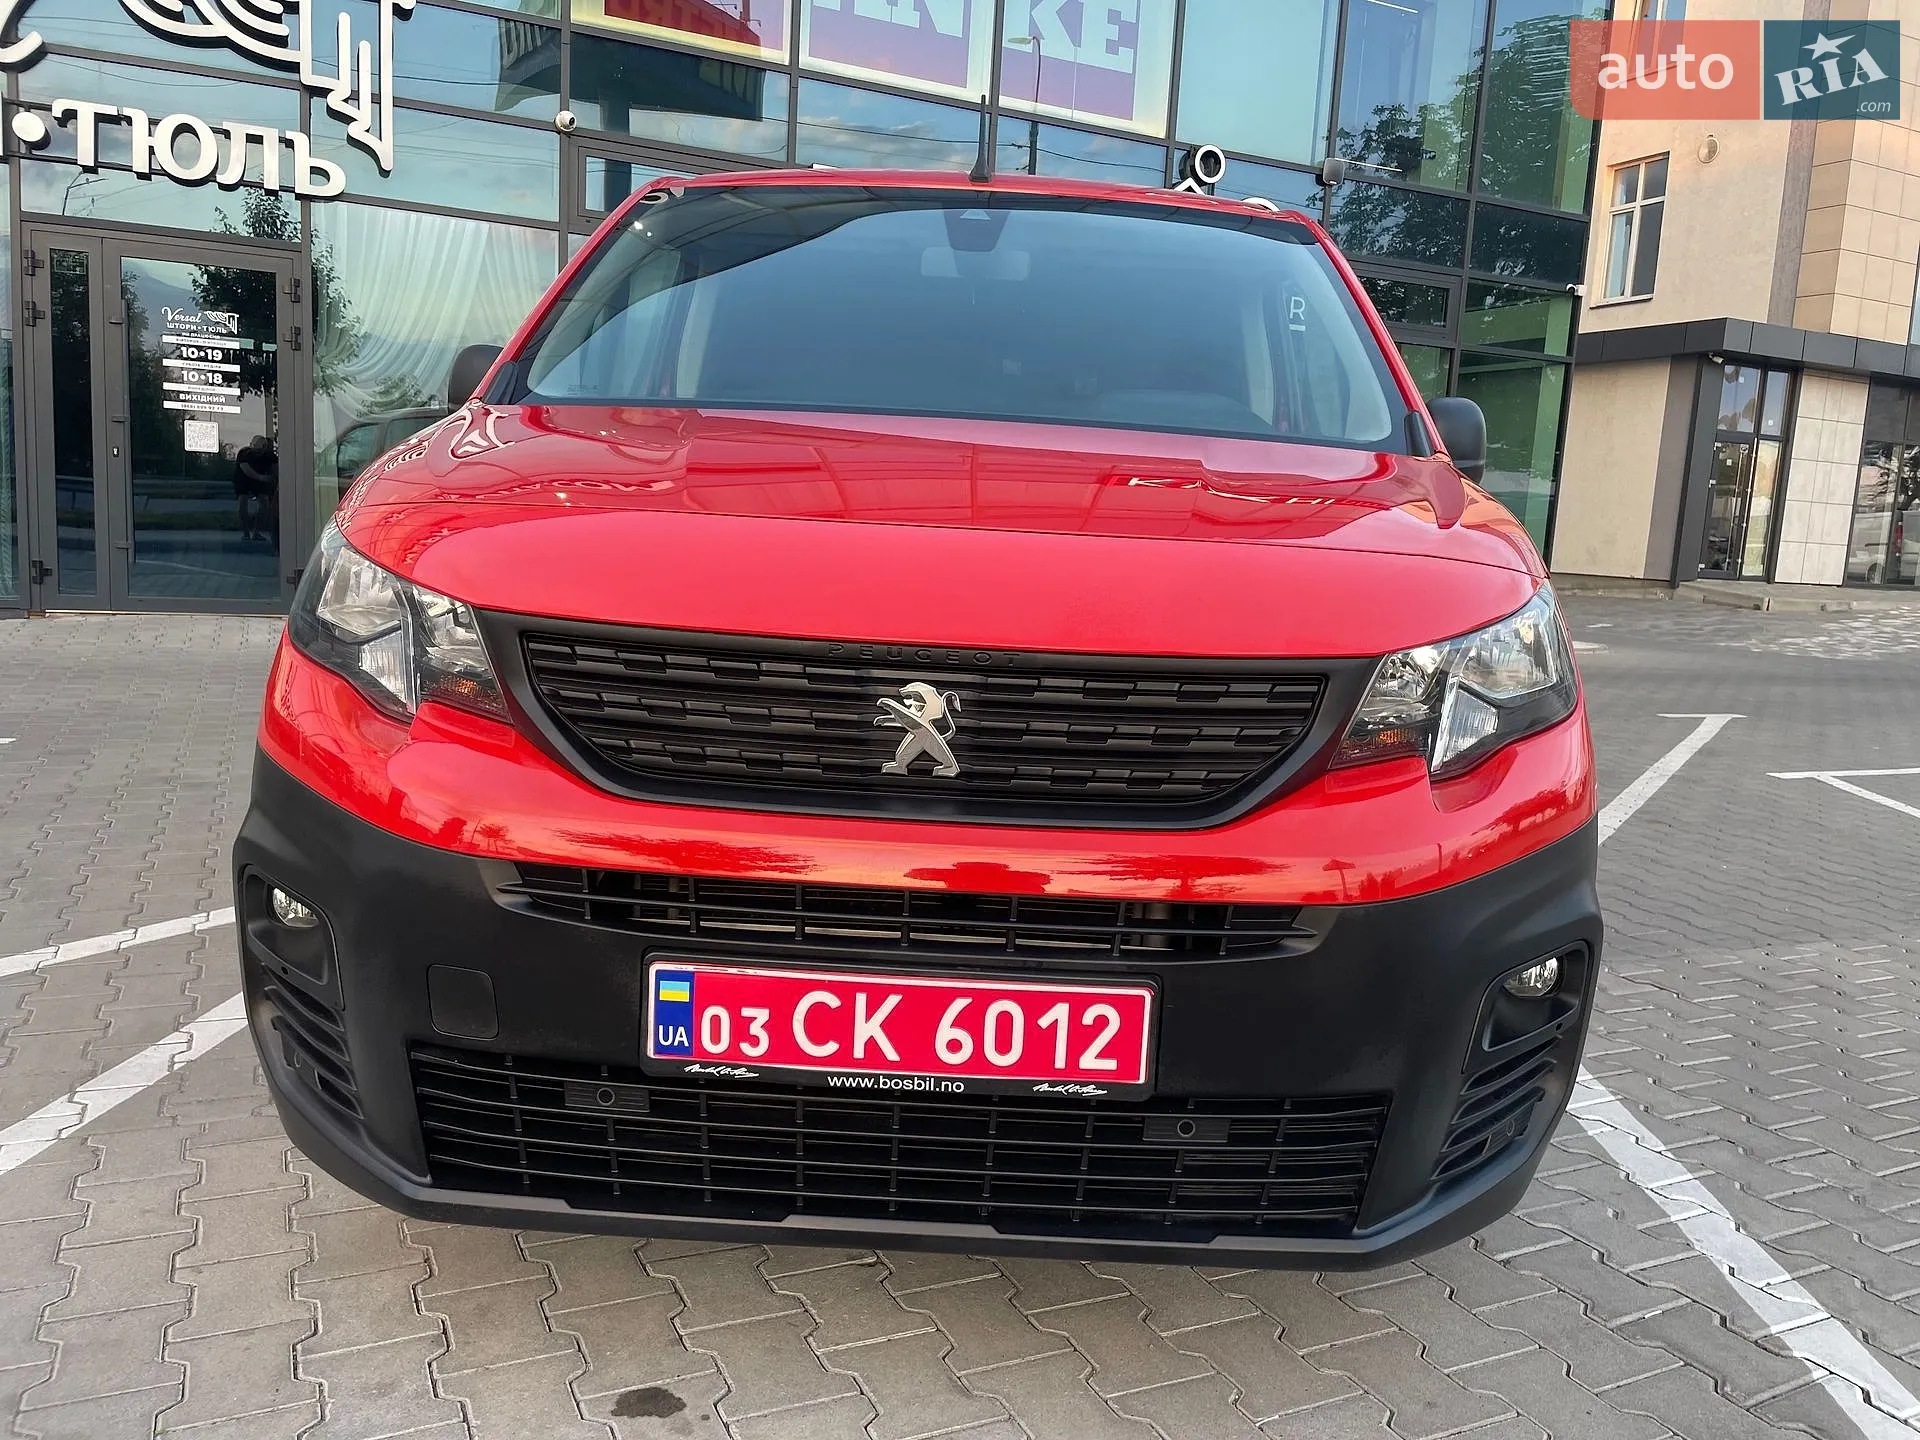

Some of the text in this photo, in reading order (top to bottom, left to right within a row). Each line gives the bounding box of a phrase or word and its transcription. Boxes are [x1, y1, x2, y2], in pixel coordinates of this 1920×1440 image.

[161, 306, 202, 322] Versal
[1290, 296, 1305, 320] R
[828, 643, 1021, 667] PEUGEOT
[658, 1024, 690, 1047] UA
[700, 990, 1121, 1071] 03 CK 6012
[827, 1074, 965, 1094] www.bosbil.no
